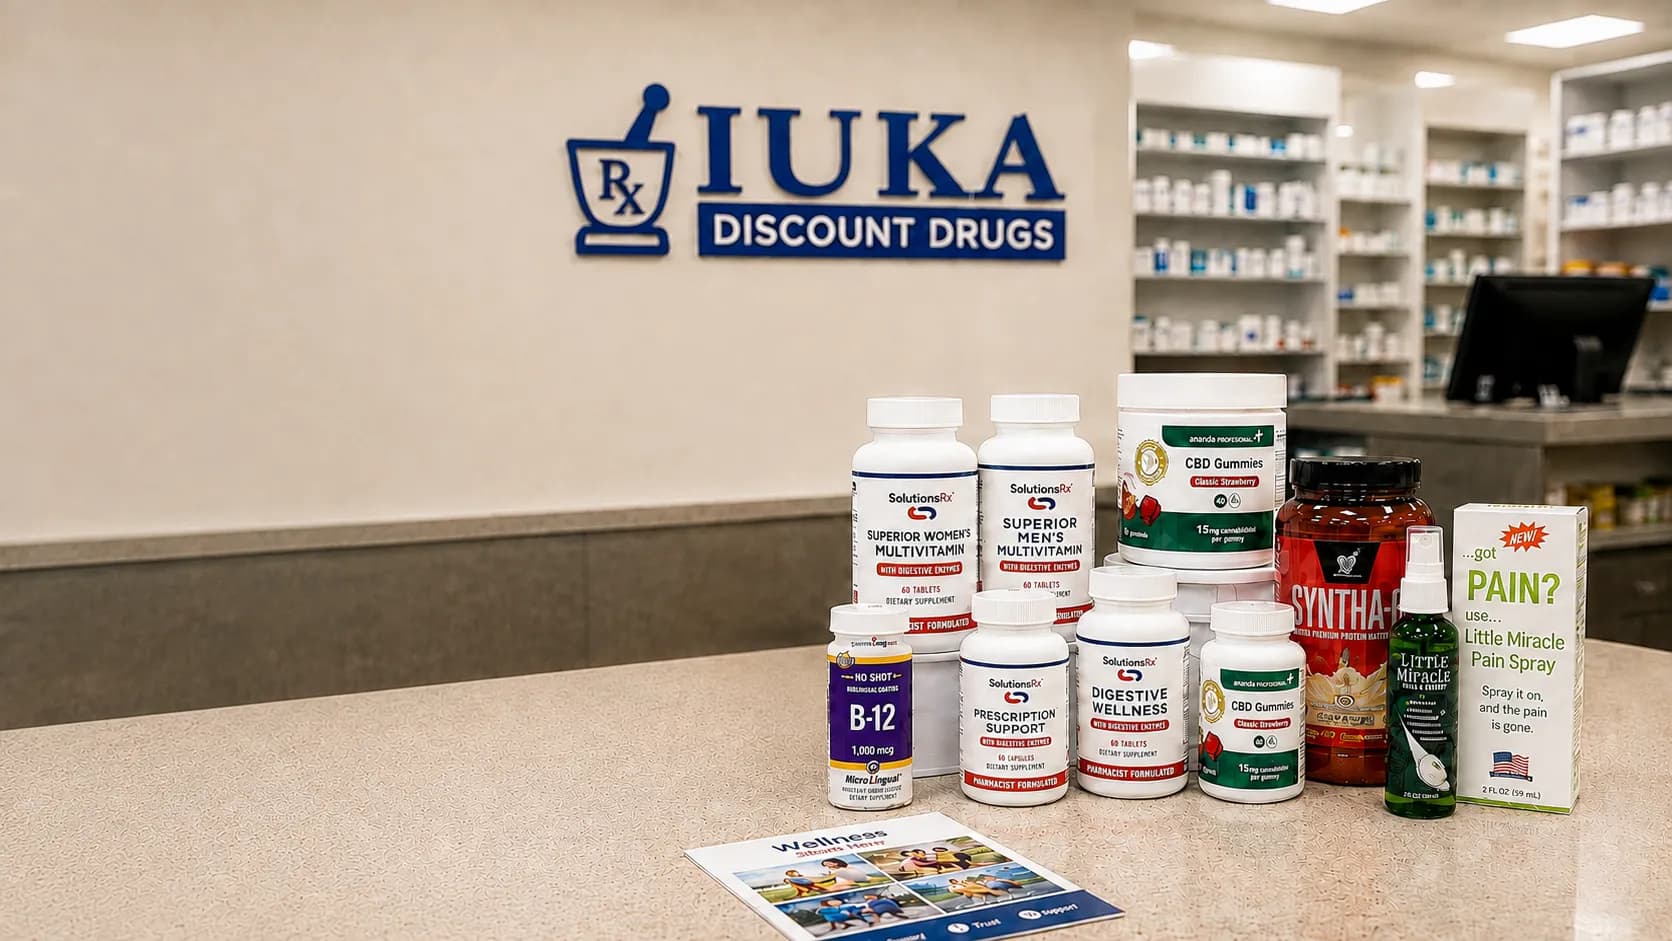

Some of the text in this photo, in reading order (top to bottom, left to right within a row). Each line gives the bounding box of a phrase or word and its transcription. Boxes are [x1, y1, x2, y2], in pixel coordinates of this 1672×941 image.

[697, 106, 1066, 201] IUKA
[713, 213, 1054, 250] DISCOUNT DRUGS
[1189, 435, 1216, 443] ananda
[1185, 457, 1263, 469] CBD Gummies
[1010, 482, 1073, 494] SolutionsRx
[888, 491, 955, 504] SolutionsRx
[1003, 517, 1077, 530] SUPERIOR
[867, 529, 971, 542] SUPERIOR WOMEN'S
[1018, 532, 1064, 543] MEN'S
[1509, 530, 1537, 545] NEW!
[875, 543, 965, 558] MULTIVITAMIN
[997, 544, 1082, 557] MULTIVITAMIN
[901, 586, 941, 594] 60 TABLETS
[1023, 581, 1060, 589] 60 TABLETS
[1468, 570, 1561, 604] PAIN?
[886, 595, 955, 605] DIETARY SUPPLEMENT
[1465, 610, 1502, 623] use...
[1465, 628, 1565, 650] Little Miracle
[1102, 656, 1158, 667] SolutionsRx
[1472, 651, 1556, 676] Pain Spray
[855, 672, 893, 682] NO SHOT
[989, 678, 1044, 688] SolutionsRx
[1092, 686, 1168, 701] DIGESTIVE
[1482, 685, 1514, 701] Spray
[1516, 688, 1524, 699] it
[1092, 701, 1168, 716] WELLNESS
[1231, 700, 1294, 712] CBD Gummies
[1479, 704, 1548, 719] and the pain
[850, 703, 896, 731] B-12
[974, 708, 1056, 722] PRESCRIPTION
[986, 723, 1046, 734] SUPPORT
[1491, 719, 1534, 734] is gone.
[1110, 739, 1148, 748] 60 TABLETS
[852, 746, 894, 756] 1,000 mcg
[1086, 765, 1175, 778] PHARMACIST FORMULATED
[1488, 787, 1497, 795] FL
[1512, 789, 1524, 798] (59
[771, 830, 888, 852] Wellness
[971, 918, 1002, 929] Trust
